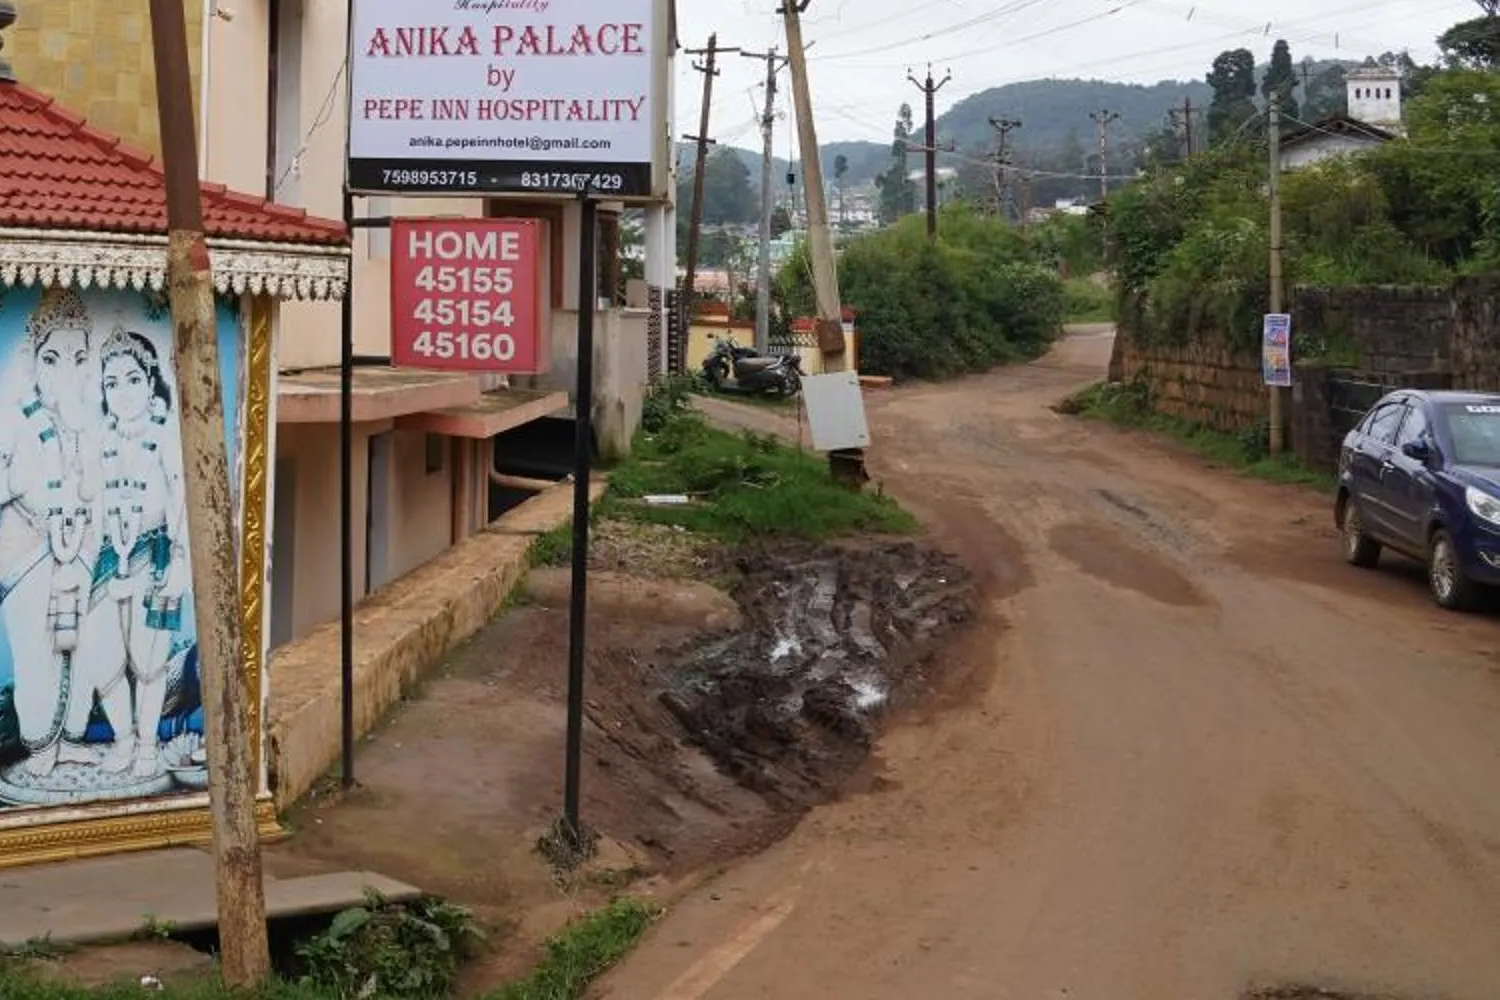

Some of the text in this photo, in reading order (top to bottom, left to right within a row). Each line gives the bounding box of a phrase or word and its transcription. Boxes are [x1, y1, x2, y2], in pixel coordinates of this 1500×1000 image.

[366, 22, 645, 57] ANIKA PALACE
[487, 65, 516, 93] by
[363, 96, 646, 122] PEPE INN HOSPITALITY
[409, 135, 611, 151] anika.pepeinnhotel@gmail.com
[382, 170, 477, 186] 7598953715
[408, 230, 521, 261] HOME
[414, 265, 514, 294] 45155
[413, 298, 515, 328] 45154
[412, 331, 516, 361] 45160
